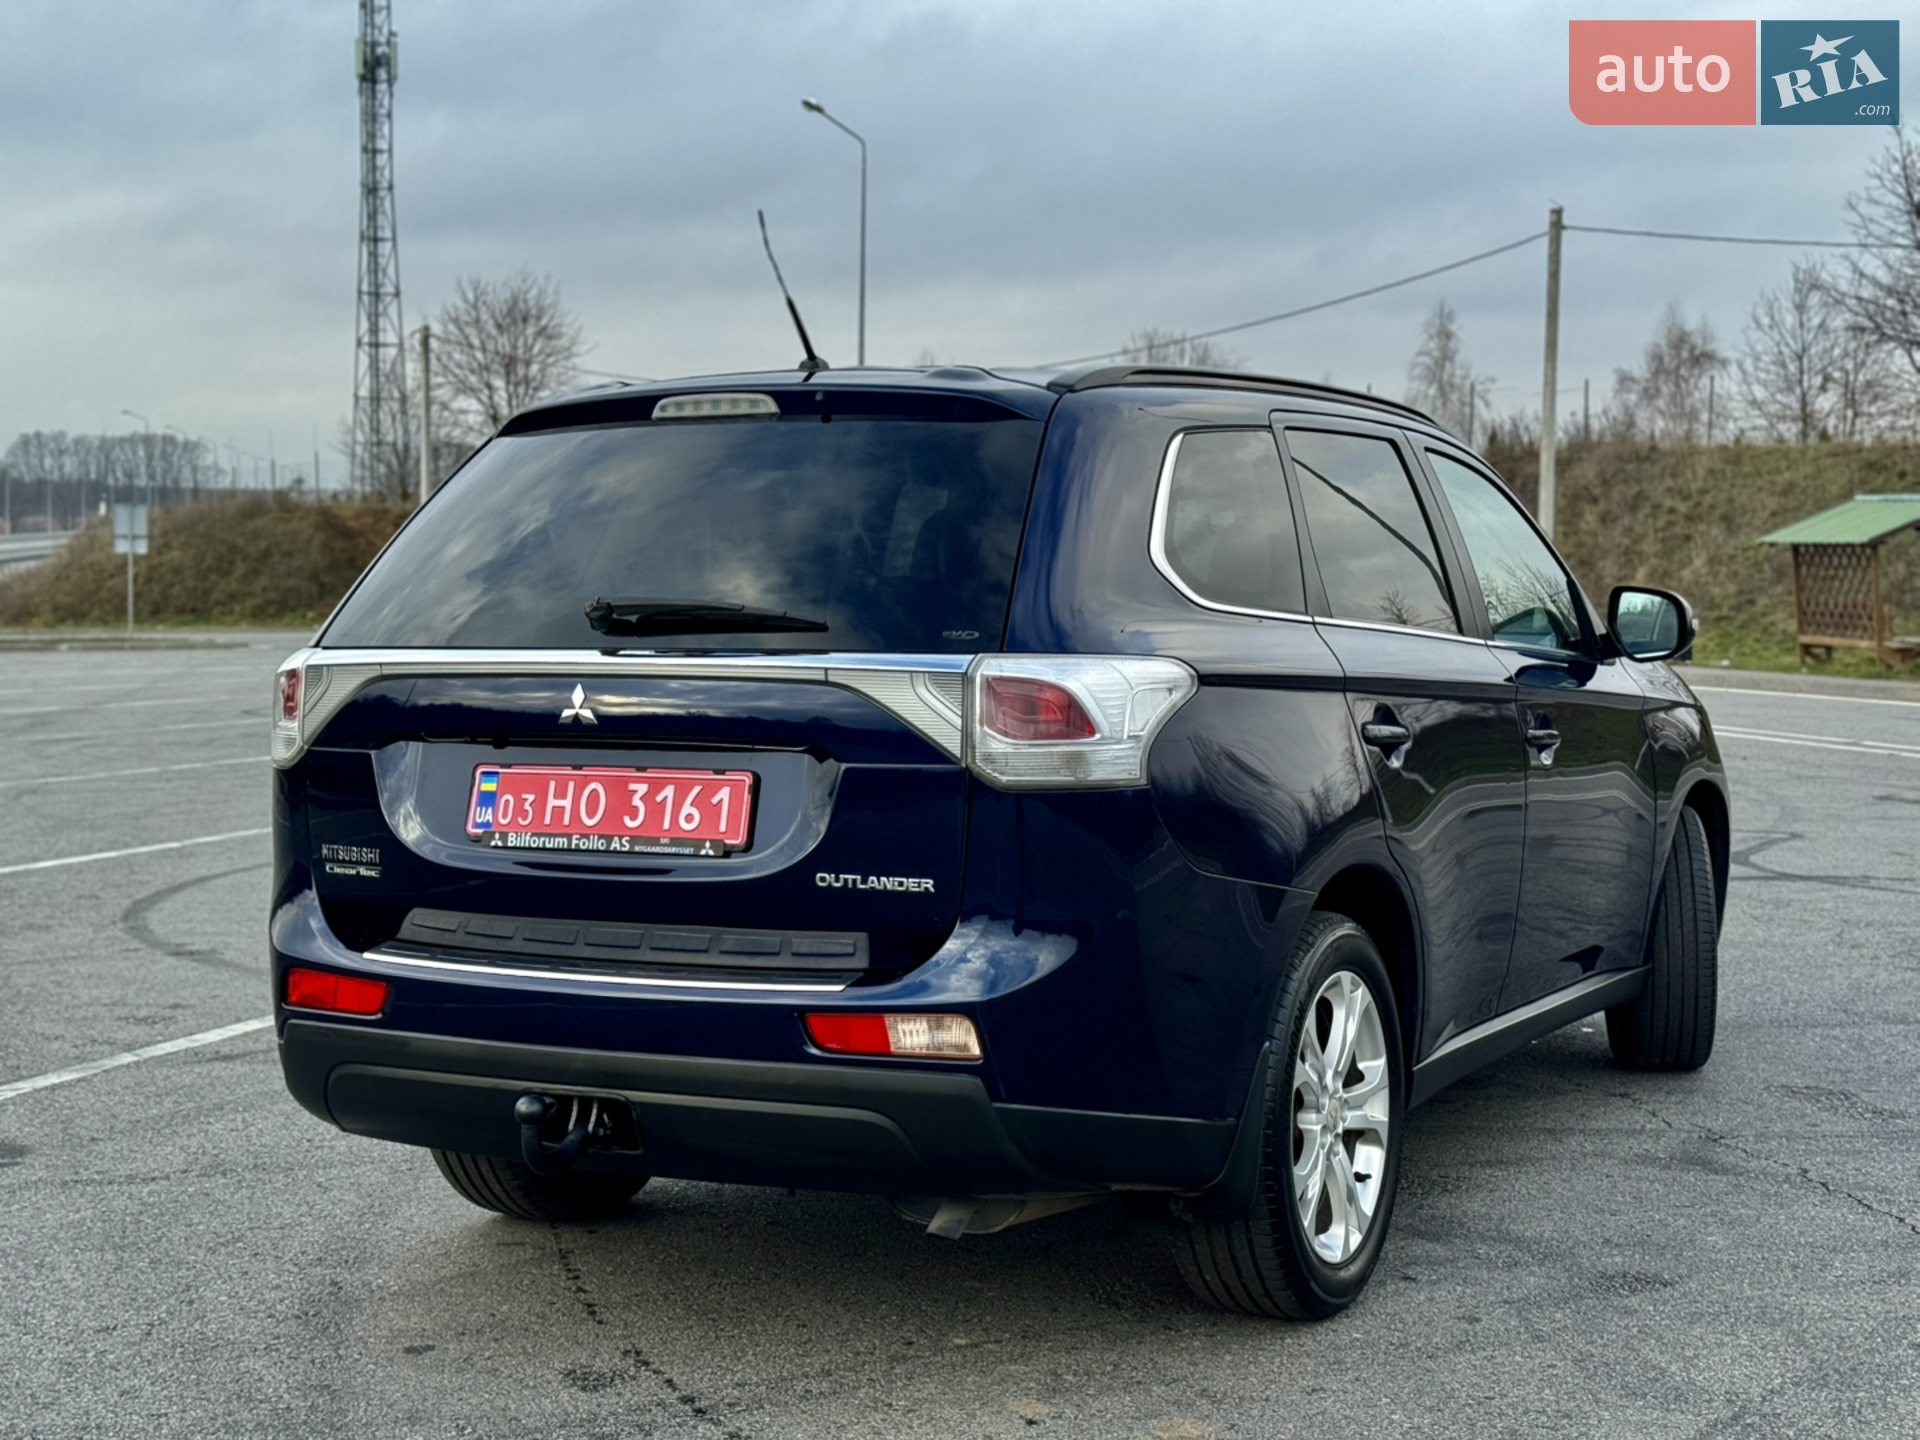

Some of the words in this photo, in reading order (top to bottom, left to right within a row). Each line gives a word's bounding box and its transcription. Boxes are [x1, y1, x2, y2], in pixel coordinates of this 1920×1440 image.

[475, 806, 494, 824] UA
[497, 793, 536, 826] 03
[543, 779, 607, 828] HO
[622, 782, 732, 833] 3161
[507, 832, 568, 848] Bilforum
[571, 834, 607, 850] Follo
[610, 836, 631, 852] AS
[321, 844, 380, 864] MITSUBISHI
[815, 872, 936, 893] OUTLANDER
